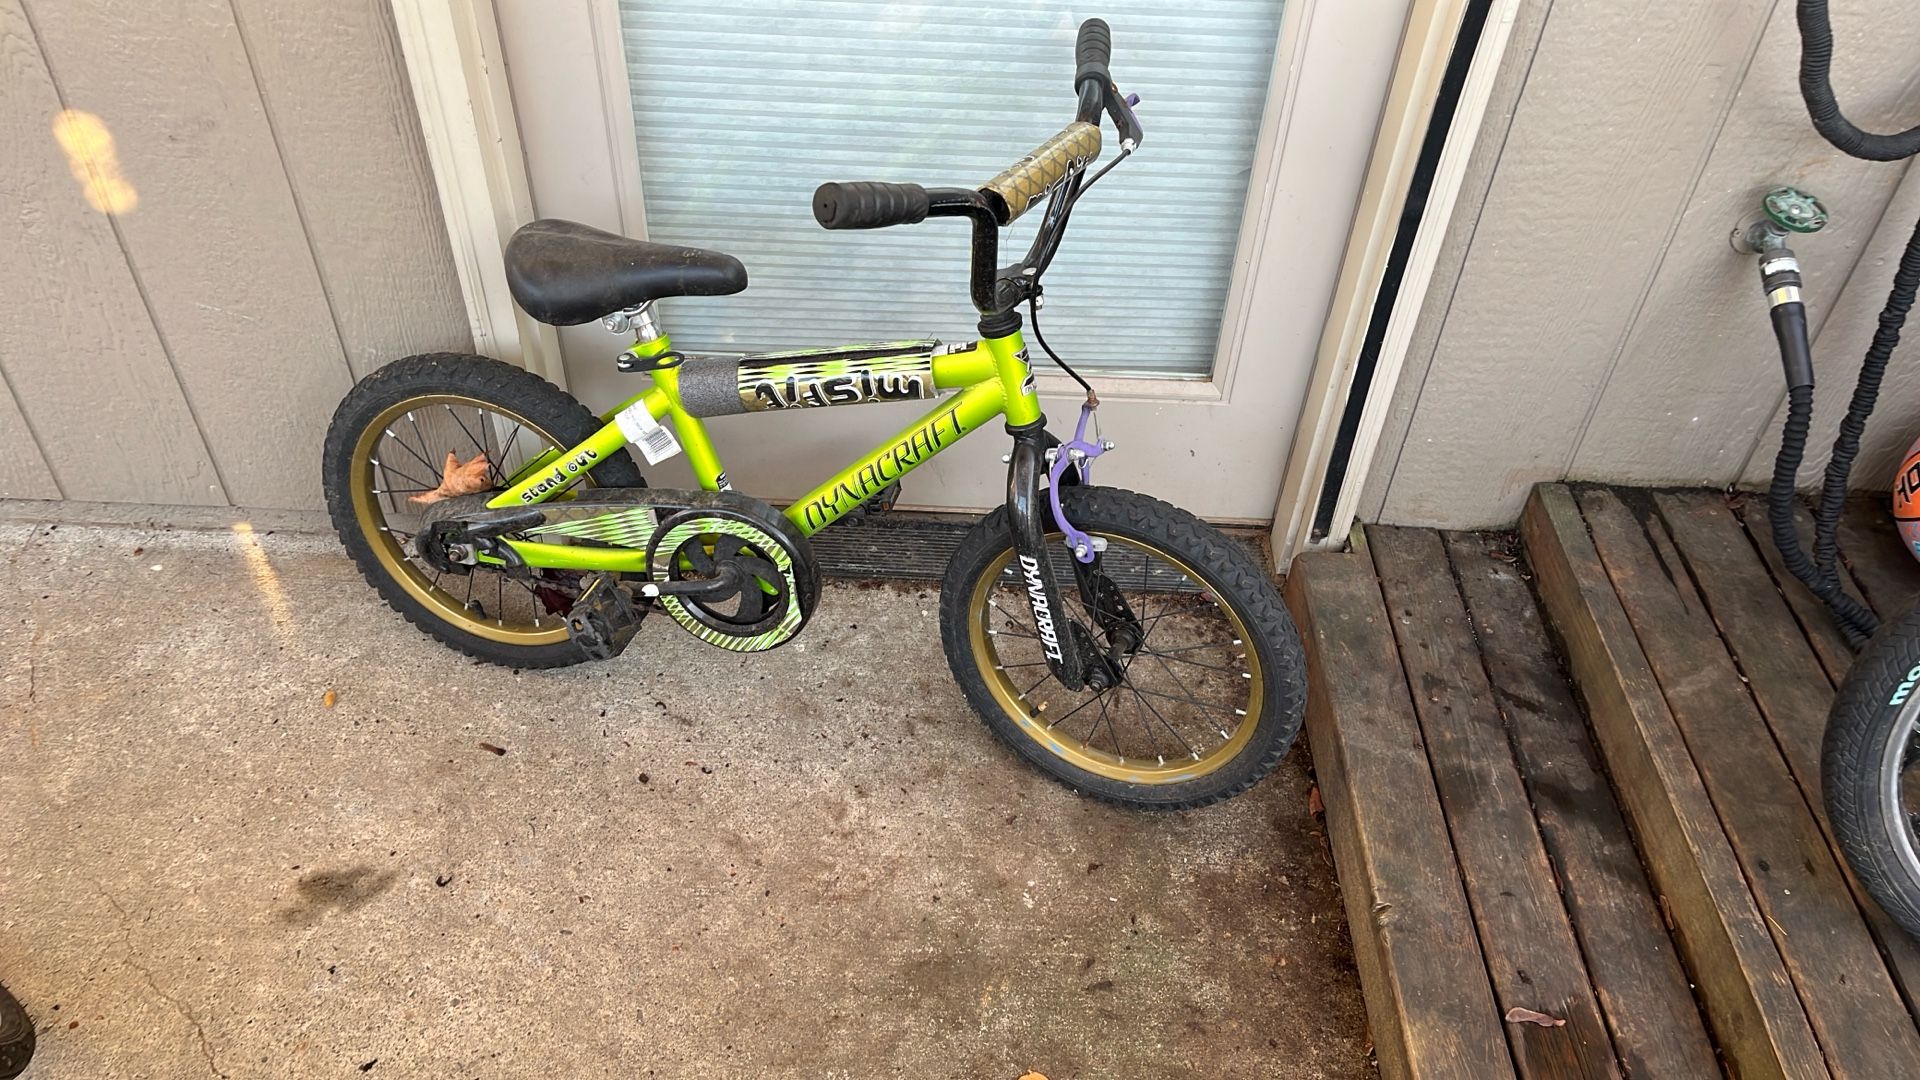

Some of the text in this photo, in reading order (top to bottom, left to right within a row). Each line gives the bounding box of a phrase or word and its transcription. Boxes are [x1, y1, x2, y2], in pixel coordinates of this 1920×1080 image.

[521, 450, 598, 502] stand out
[803, 401, 964, 531] DYNACRAFT
[1019, 554, 1063, 664] DYNACRAFT
